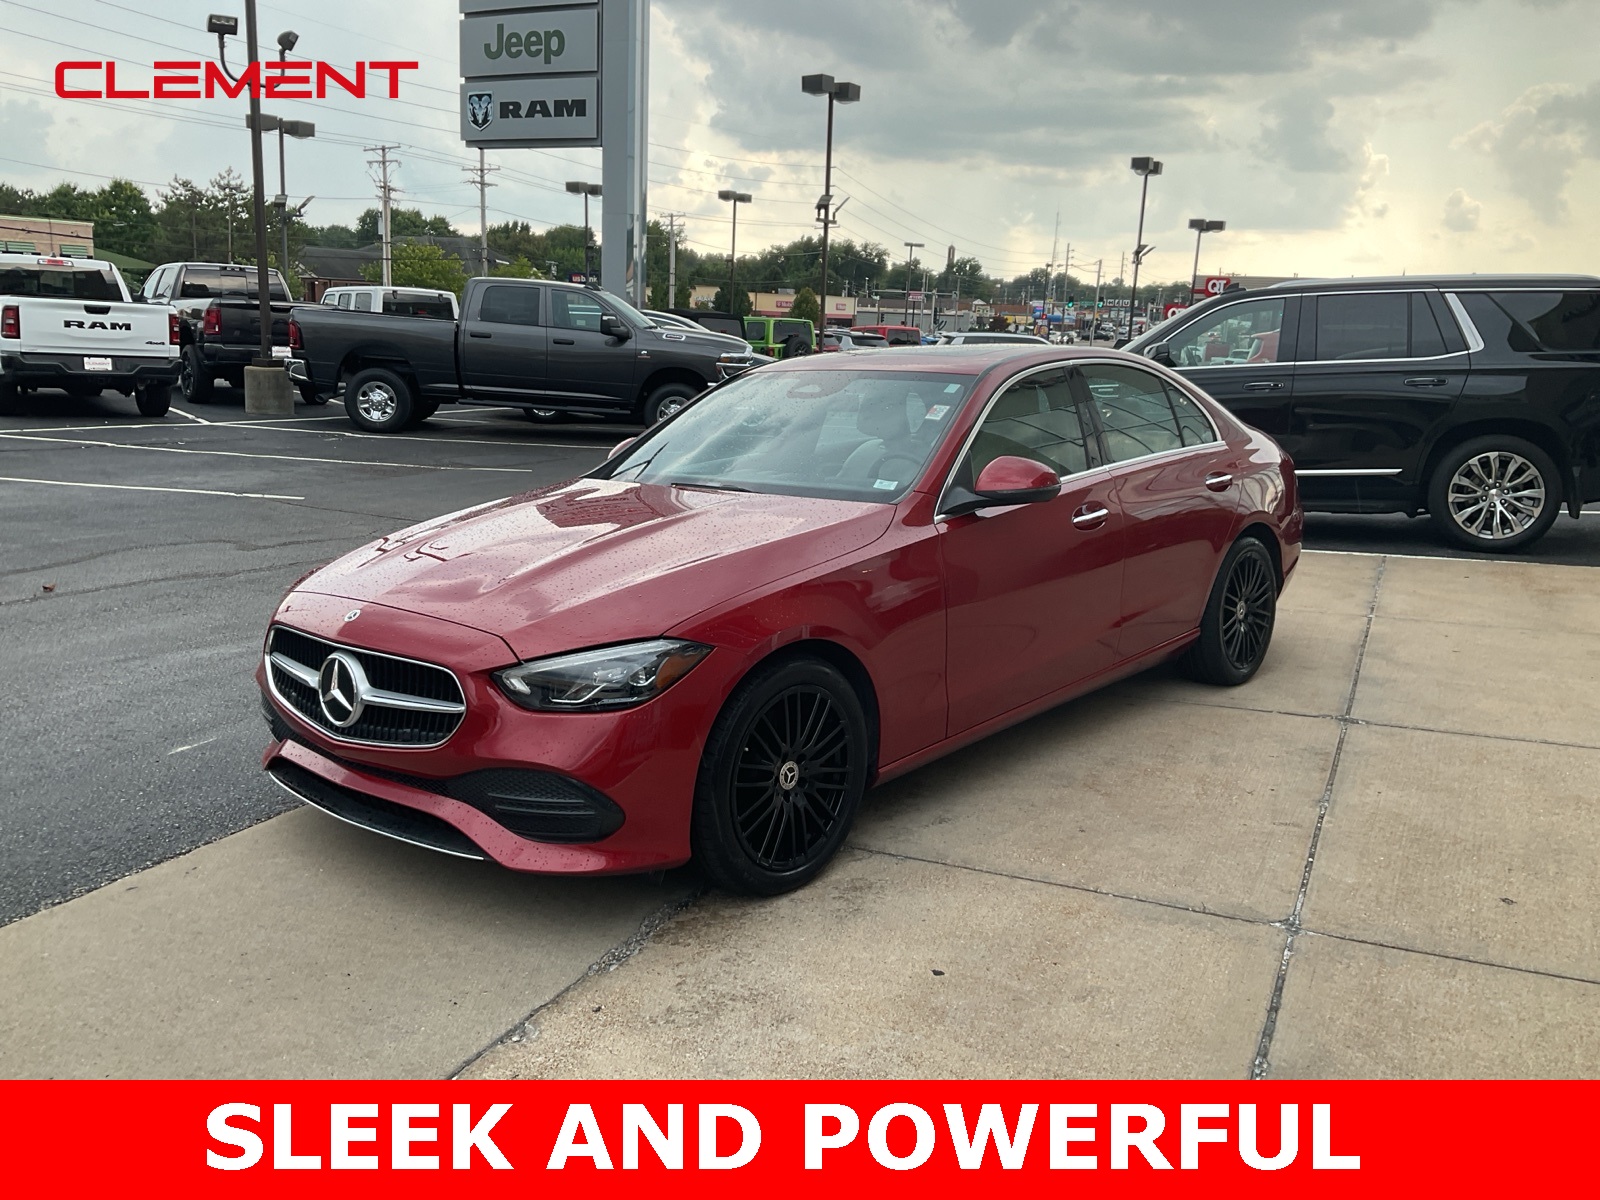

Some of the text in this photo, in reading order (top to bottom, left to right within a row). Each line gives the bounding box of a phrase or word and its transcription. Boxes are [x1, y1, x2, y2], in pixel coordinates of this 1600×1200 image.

[484, 23, 566, 65] Jeep
[499, 99, 587, 119] RAM
[1207, 279, 1227, 294] QT
[63, 319, 132, 331] RAM
